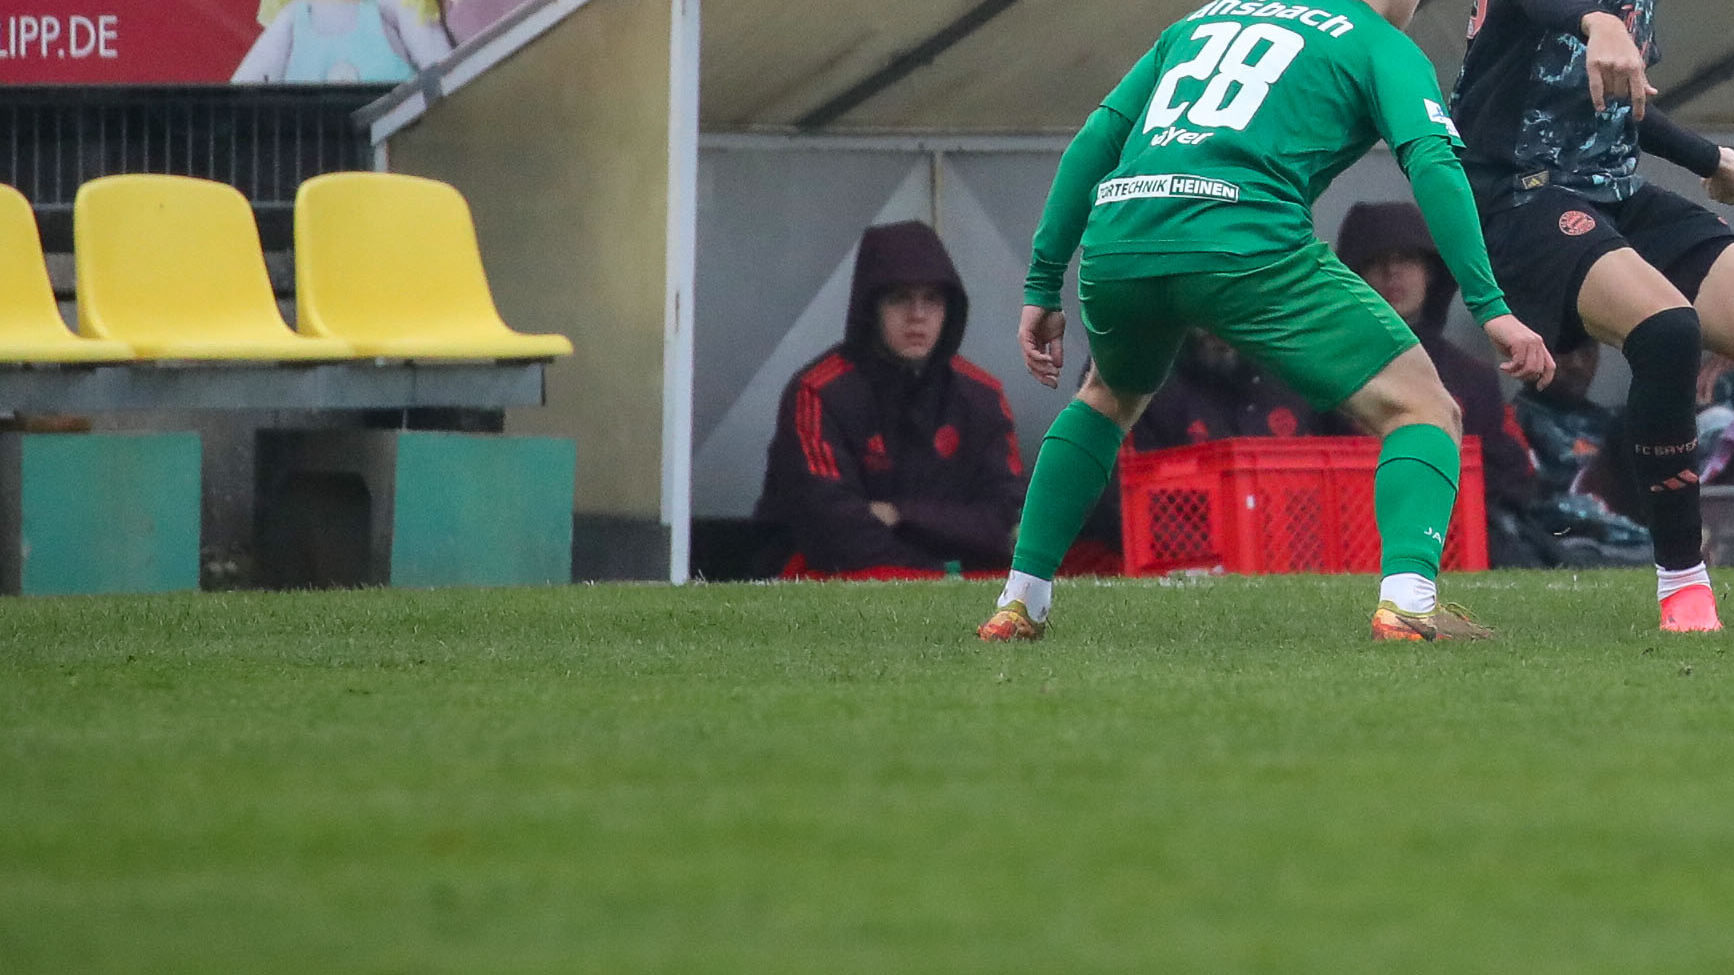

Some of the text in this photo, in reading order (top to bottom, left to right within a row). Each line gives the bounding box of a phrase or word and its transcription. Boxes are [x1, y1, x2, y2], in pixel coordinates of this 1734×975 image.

[1143, 22, 1305, 134] 28
[1172, 178, 1236, 199] HEINEN
[1424, 527, 1442, 544] JA
